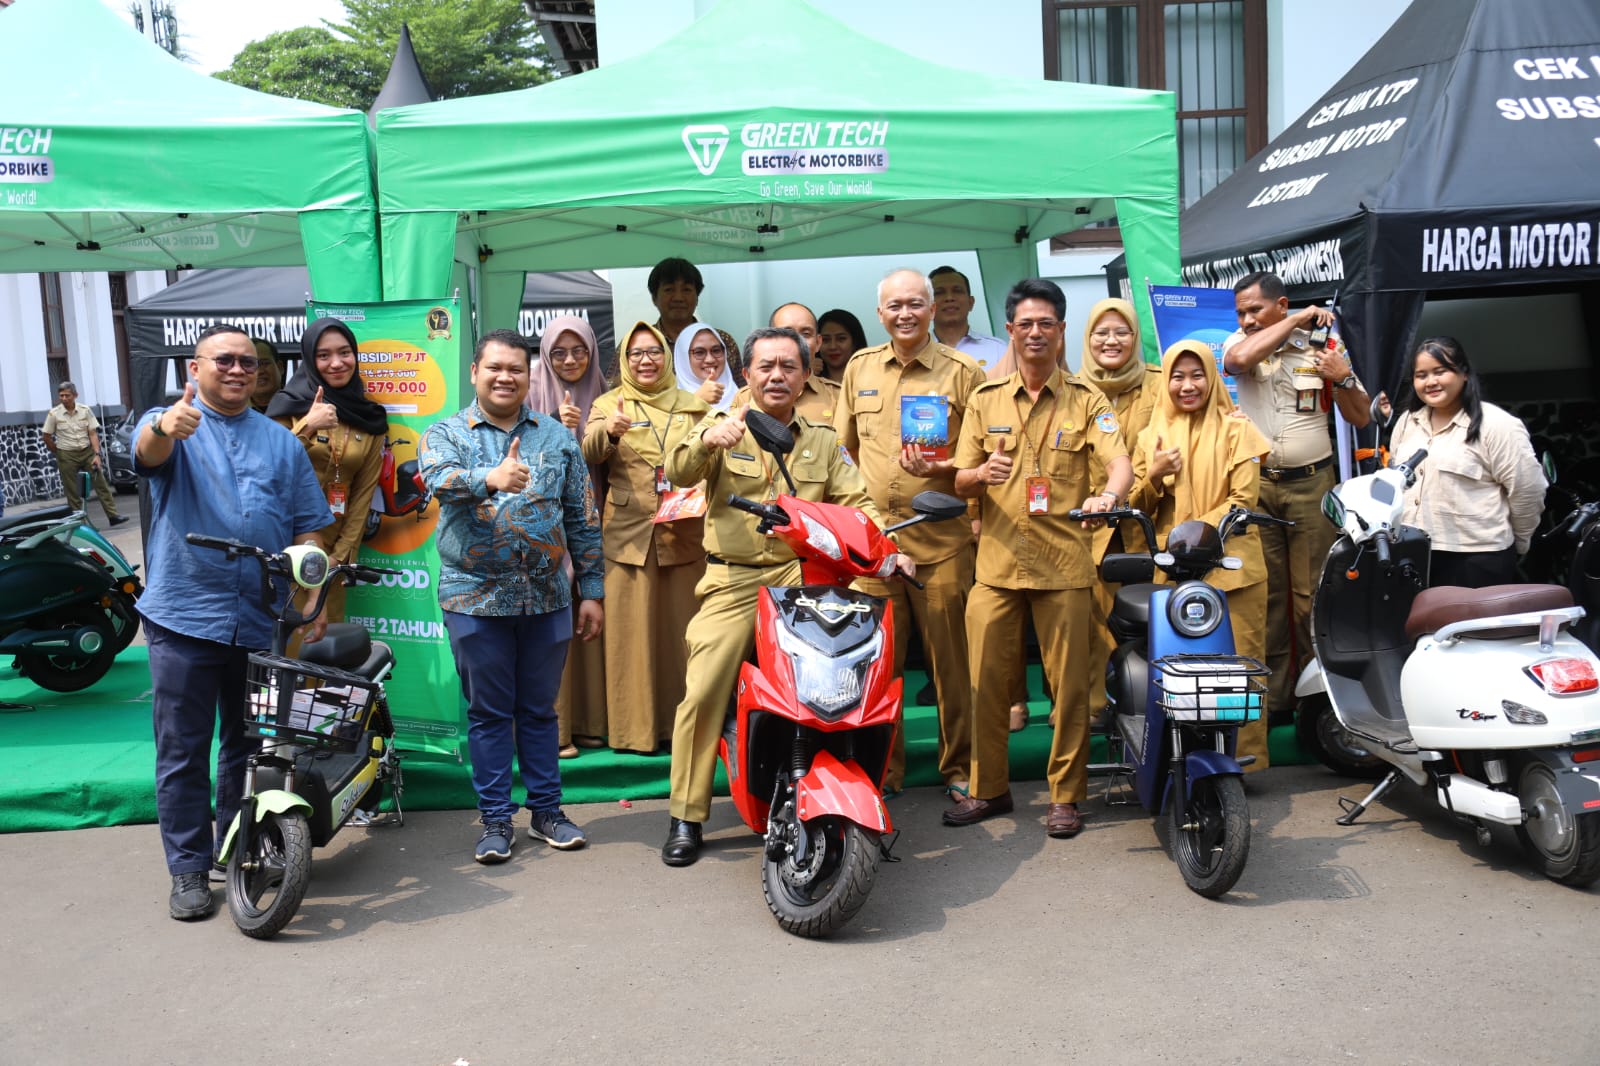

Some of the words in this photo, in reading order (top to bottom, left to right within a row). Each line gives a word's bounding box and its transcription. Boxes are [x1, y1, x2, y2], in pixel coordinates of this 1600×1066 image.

[1513, 57, 1590, 81] CEK
[1306, 97, 1349, 129] CEK
[1338, 86, 1380, 118] NIK
[1370, 77, 1419, 109] KTP
[1496, 95, 1600, 121] SUBS
[0, 127, 53, 154] ECH
[741, 121, 821, 148] GREEN
[825, 120, 890, 147] TECH
[1258, 133, 1336, 173] SUBSIDI
[1325, 116, 1408, 156] MOTOR
[809, 153, 884, 168] MOTORBIKE
[760, 180, 771, 197] Go
[804, 180, 825, 196] Save
[828, 180, 842, 196] Our
[1247, 172, 1329, 208] LISTRIK
[1422, 226, 1503, 272] HARGA
[1509, 222, 1591, 269] MOTOR
[163, 317, 215, 346] HARG
[221, 316, 278, 343] OTOR
[405, 352, 412, 362] 7
[414, 352, 427, 362] JT
[377, 617, 388, 634] 2
[389, 618, 444, 639] TAHUN
